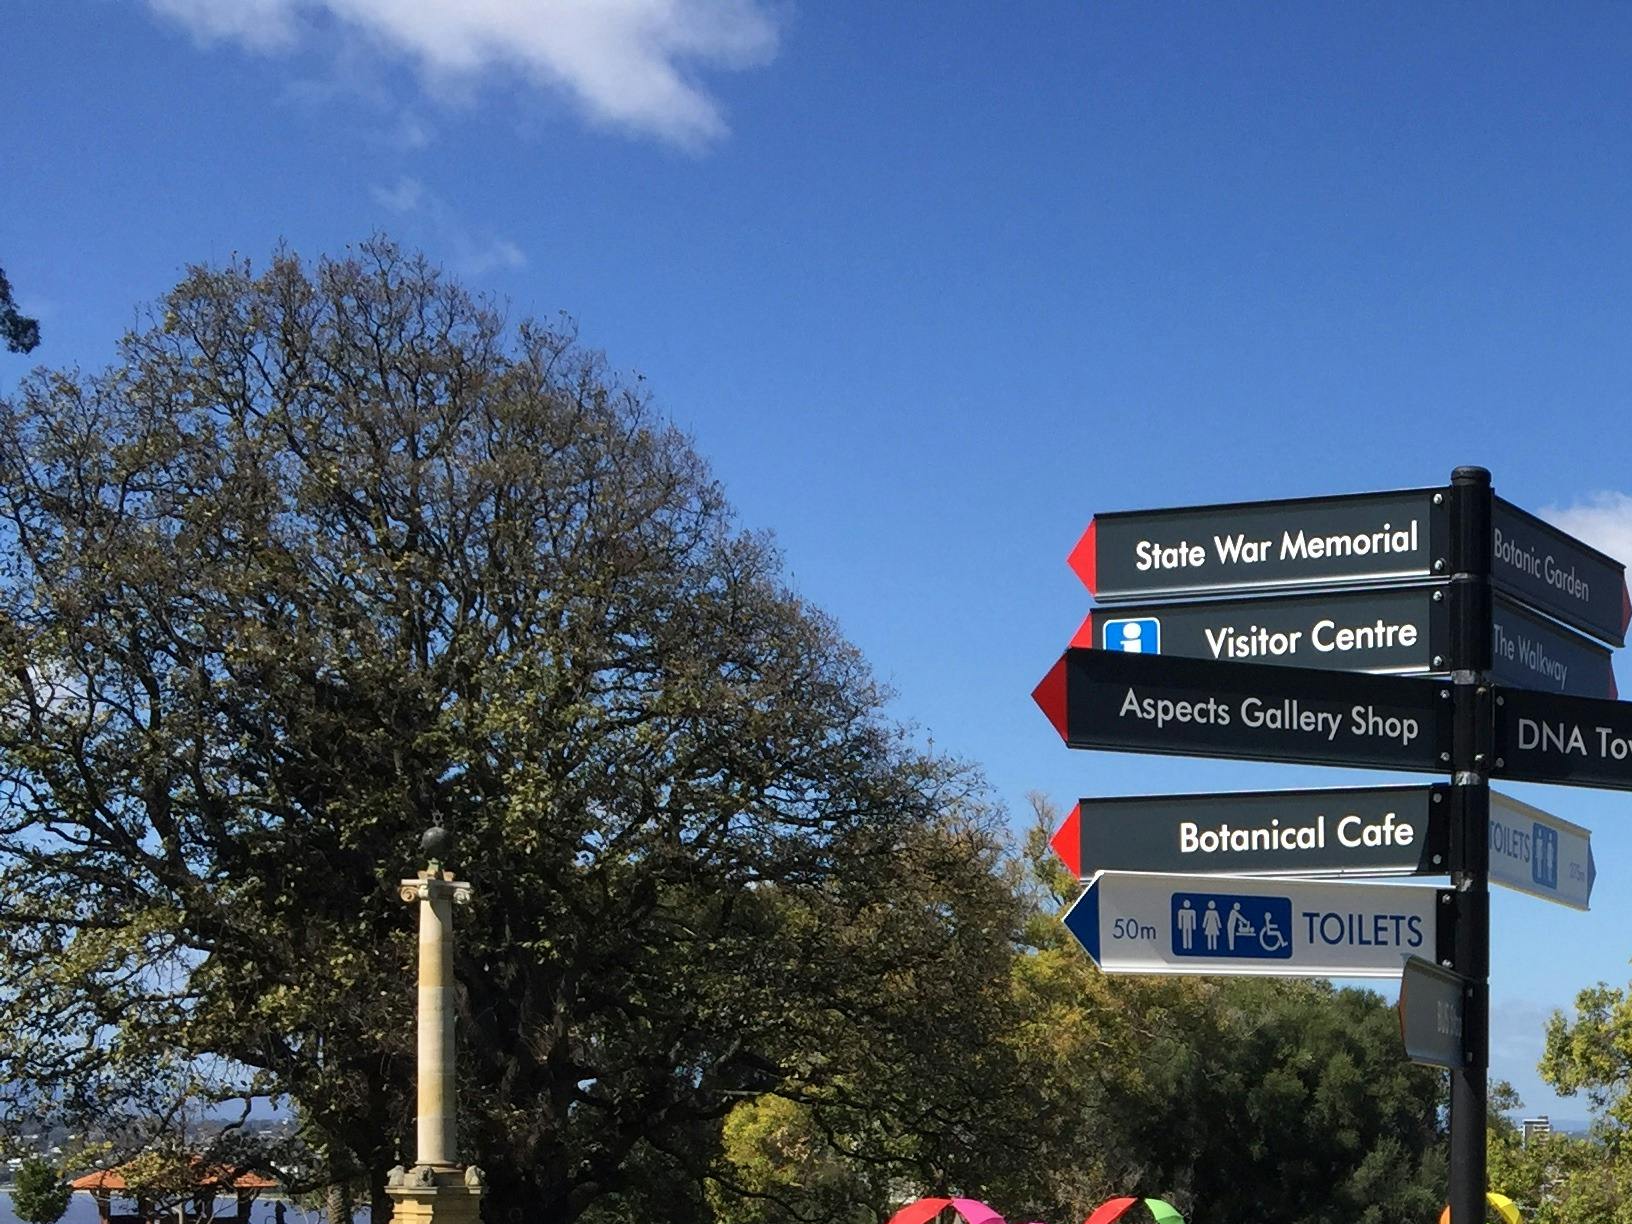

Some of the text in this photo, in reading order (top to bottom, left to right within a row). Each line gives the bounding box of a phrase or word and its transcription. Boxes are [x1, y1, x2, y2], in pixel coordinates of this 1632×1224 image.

[1136, 520, 1418, 571] State War Memorial
[1494, 528, 1589, 602] Botanic Garden
[1205, 620, 1418, 659] Visitor Centre
[1494, 624, 1568, 690] The Walkway
[1119, 688, 1419, 745] Aspects Gallery Shop
[1518, 718, 1587, 756] DNA
[1180, 813, 1415, 853] Botanical Cafe
[1488, 820, 1530, 863] TOILETS
[1112, 912, 1424, 948] 50m TOILETS
